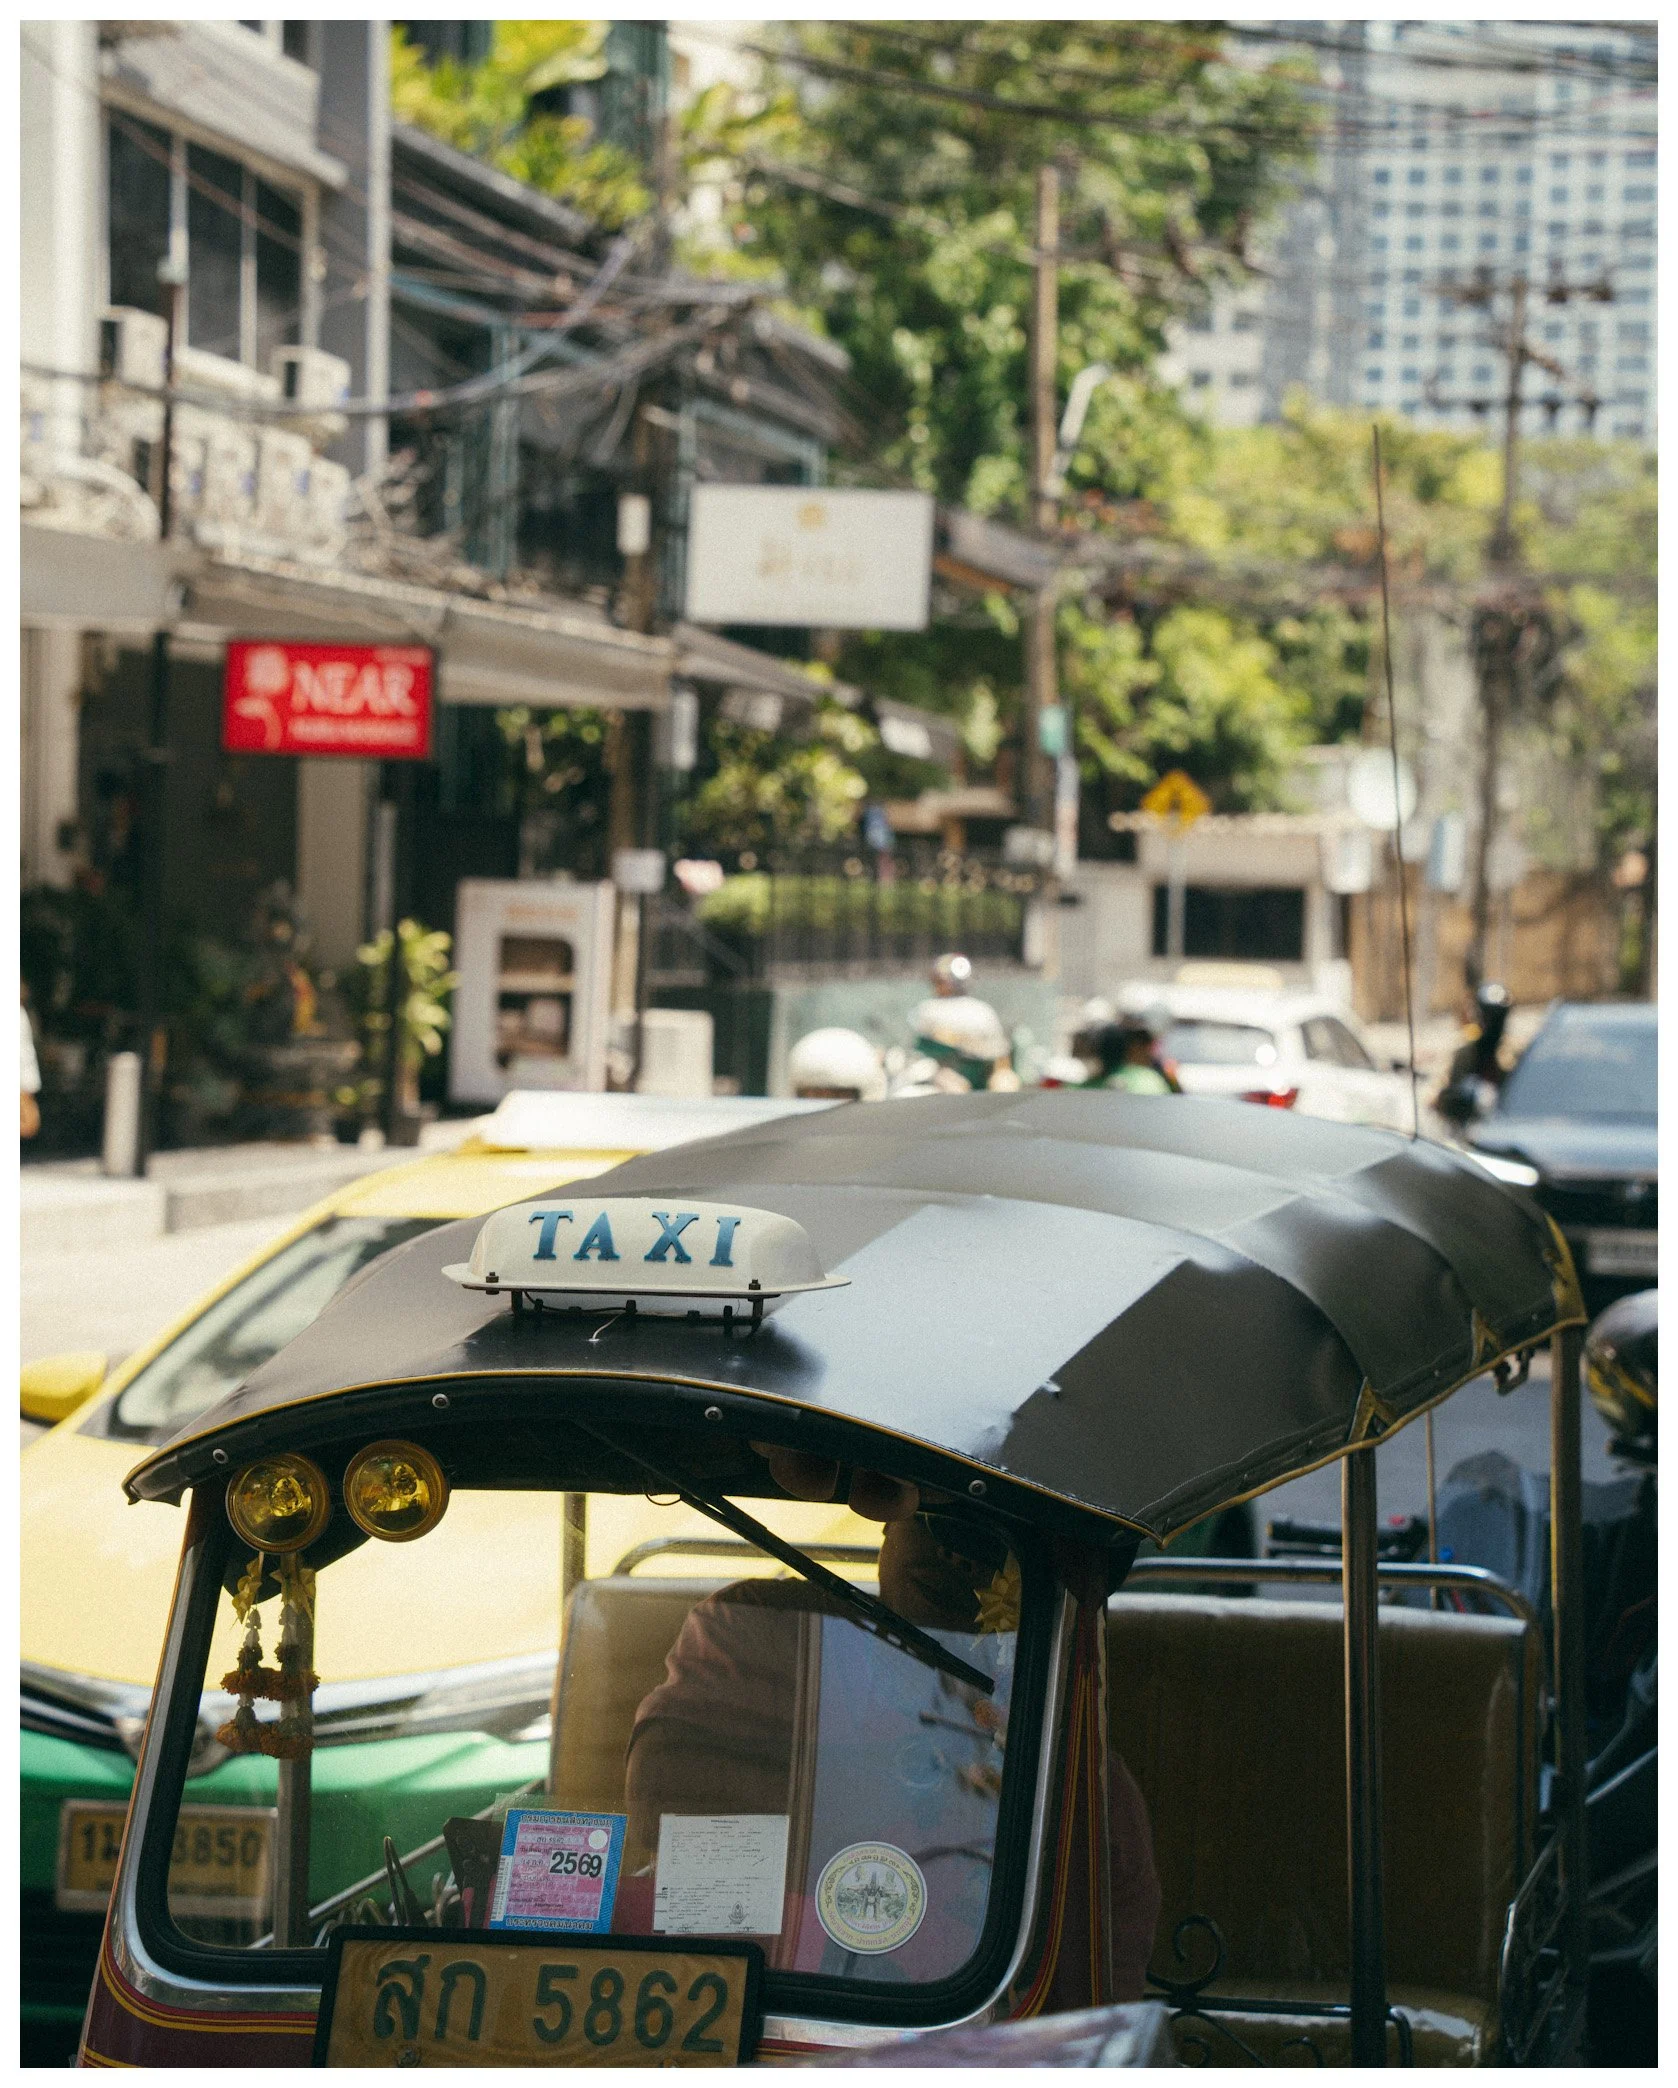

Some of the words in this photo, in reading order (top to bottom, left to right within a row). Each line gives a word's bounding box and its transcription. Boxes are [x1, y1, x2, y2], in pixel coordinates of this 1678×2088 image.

[291, 660, 418, 716] NEAR
[528, 1210, 742, 1268] TAXI
[549, 1851, 602, 1878] 2569
[373, 1953, 487, 2042] สก
[532, 1963, 730, 2053] 5862
